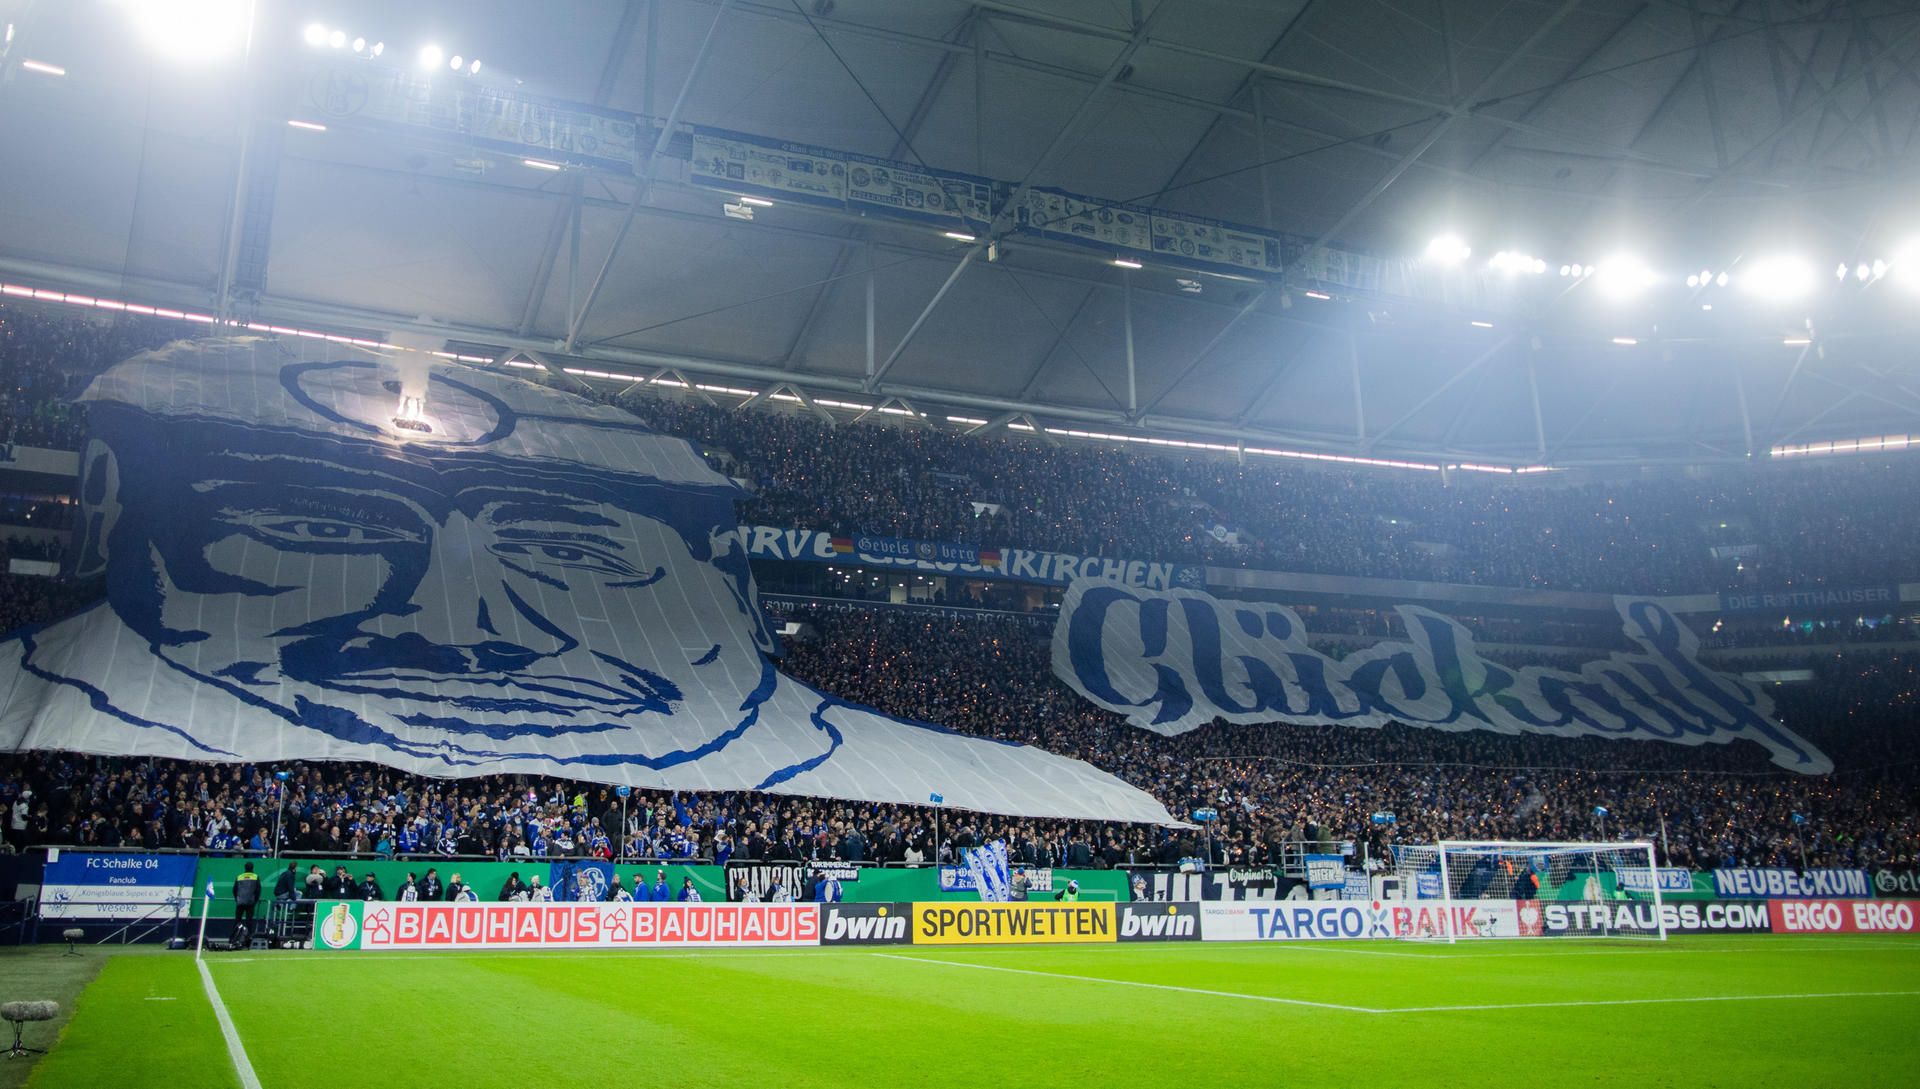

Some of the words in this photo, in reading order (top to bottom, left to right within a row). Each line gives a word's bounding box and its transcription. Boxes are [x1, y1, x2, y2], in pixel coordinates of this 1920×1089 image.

[1728, 595, 1759, 609] DIE
[86, 858, 101, 868] FC
[102, 858, 142, 869] Schalke
[144, 859, 159, 869] 04
[1229, 867, 1264, 887] Original
[109, 876, 137, 884] Fanclub
[1714, 869, 1867, 896] NEUBECKUM
[1875, 869, 1920, 893] Gel
[96, 902, 138, 912] Weseke
[1545, 903, 1769, 930] STRAUSS.COM
[1781, 903, 1842, 930] ERGO
[1852, 903, 1914, 930] ERGO
[398, 911, 599, 939] BAUHAUS
[635, 910, 817, 938] BAUHAUS
[824, 906, 907, 940] bwin
[922, 908, 1109, 937] SPORTWETTEN
[1120, 906, 1195, 937] bwin
